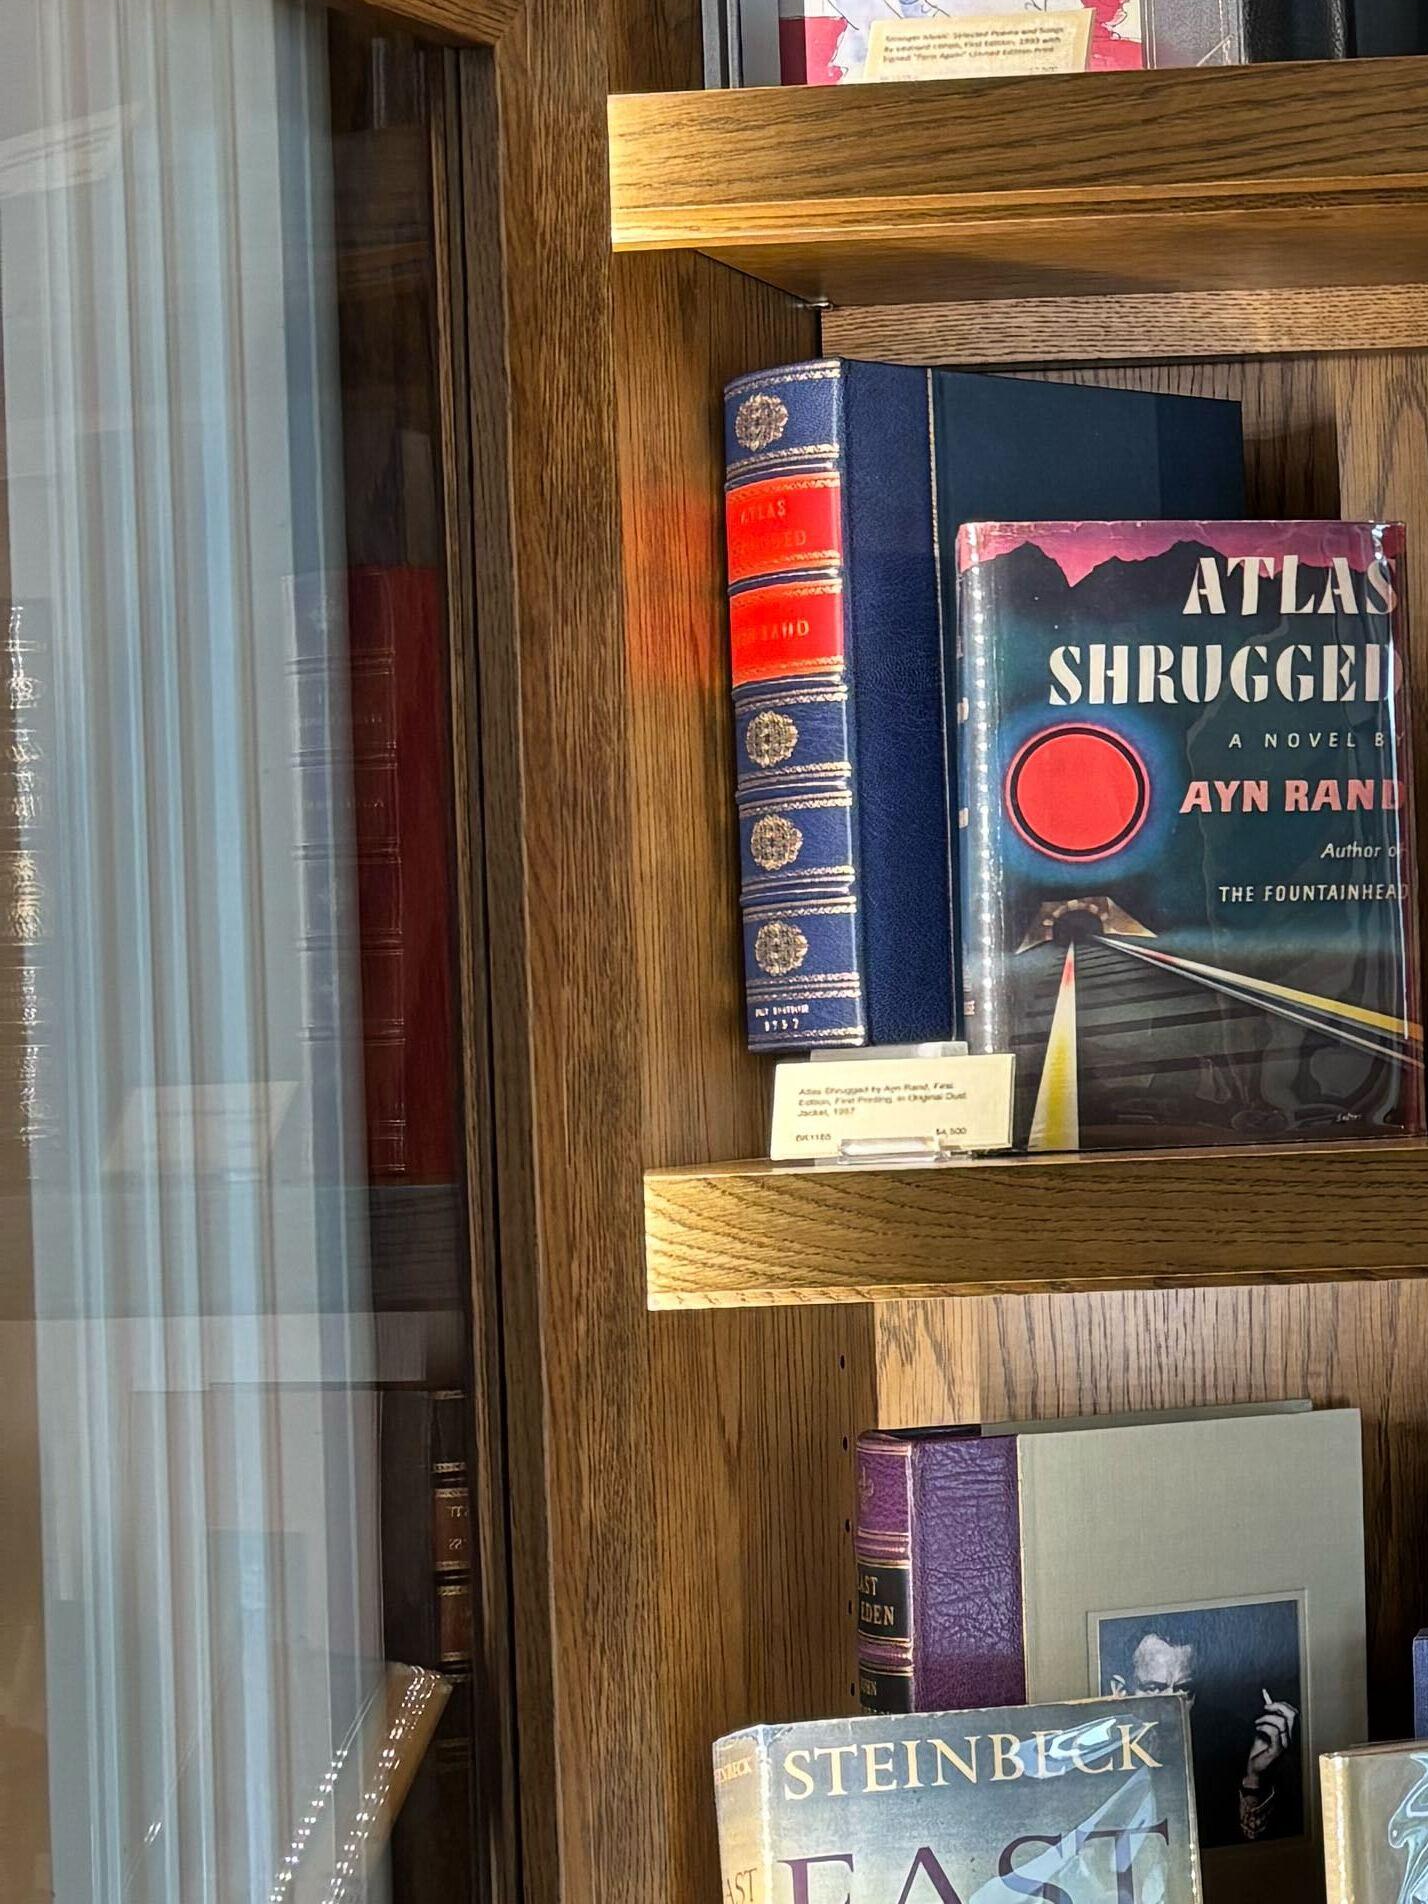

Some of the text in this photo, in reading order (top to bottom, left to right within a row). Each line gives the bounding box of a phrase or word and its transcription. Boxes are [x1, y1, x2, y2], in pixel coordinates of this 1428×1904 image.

[1182, 556, 1397, 615] ATLAS
[1229, 733, 1244, 748] A
[1264, 731, 1357, 750] NOVEL
[1180, 779, 1405, 814] AYN RAND
[1320, 840, 1381, 859] Author
[1219, 882, 1410, 903] THE FOUNTAINHEAD
[783, 1721, 1163, 1800] STEINBECK
